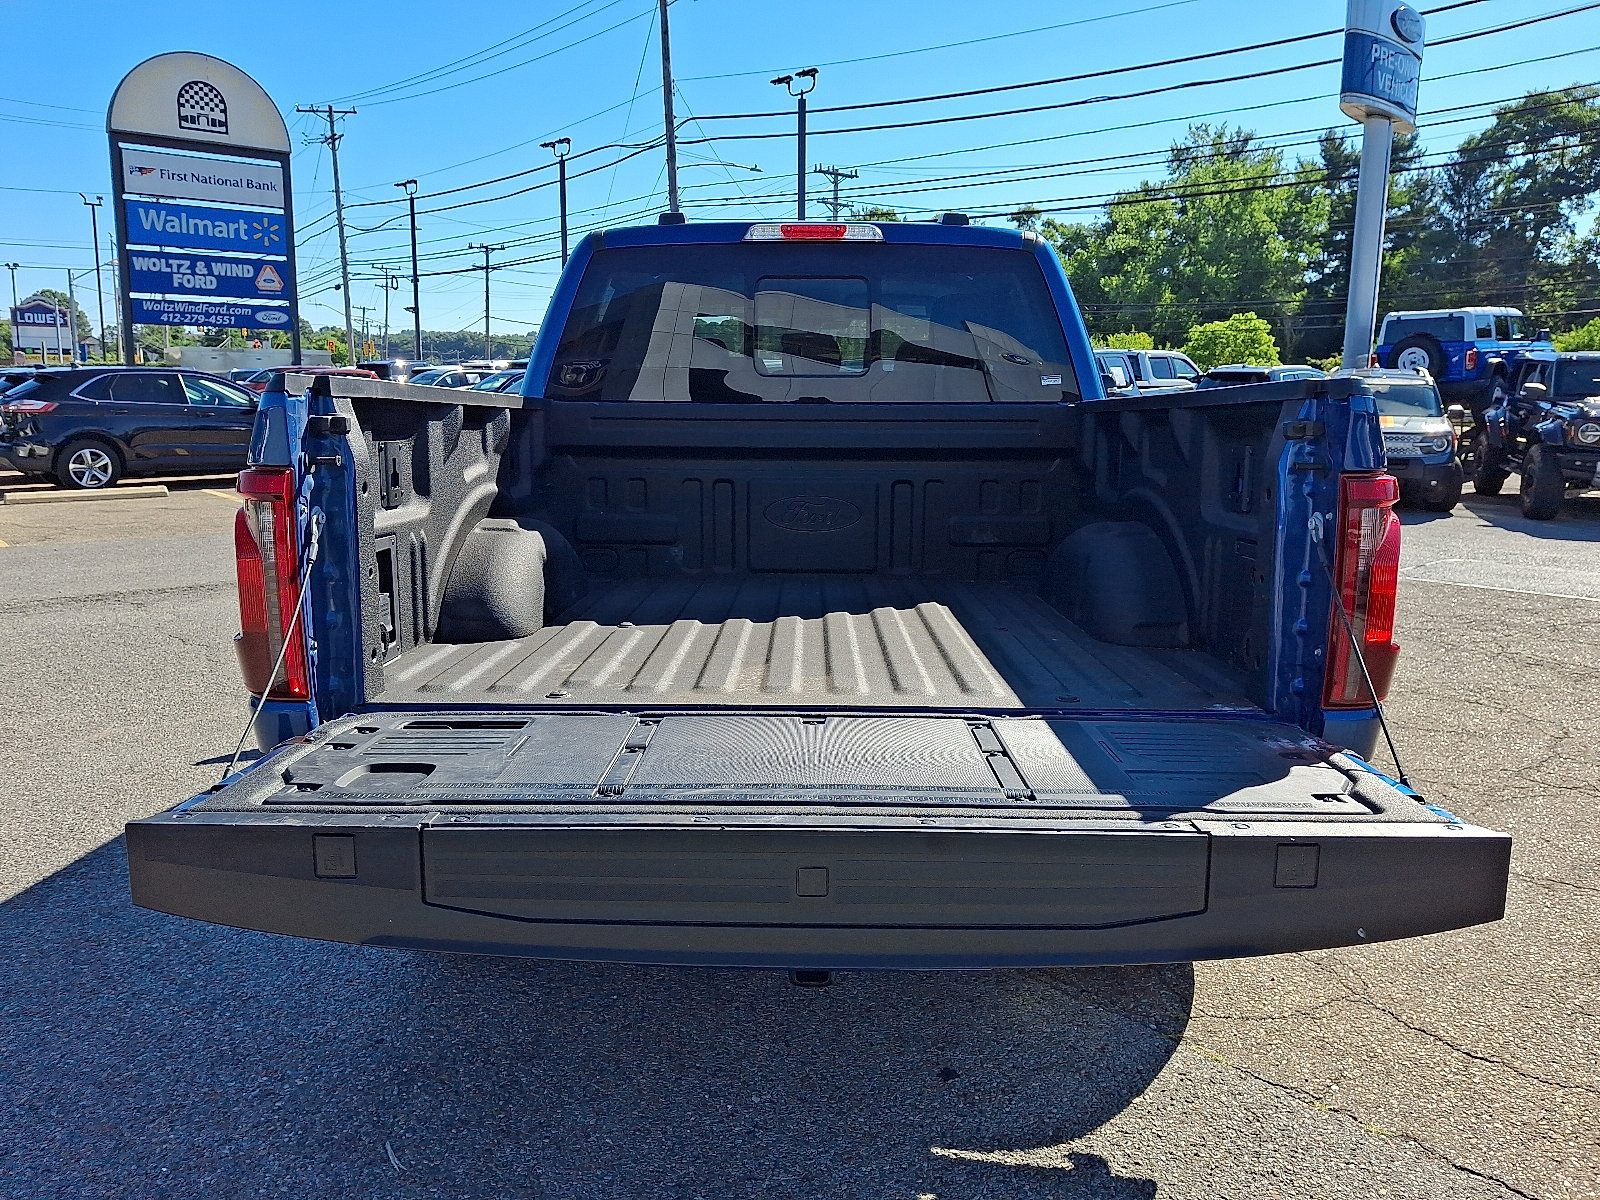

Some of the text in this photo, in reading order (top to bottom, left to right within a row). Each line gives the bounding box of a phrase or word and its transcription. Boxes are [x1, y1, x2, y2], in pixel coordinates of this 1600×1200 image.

[159, 168, 278, 192] First National Bank
[138, 207, 249, 241] Walmart
[132, 256, 254, 278] WOLTZ & WIND
[172, 274, 217, 290] FORD
[142, 300, 251, 316] WoltzWindFord.com
[160, 313, 235, 325] 412-279-4551
